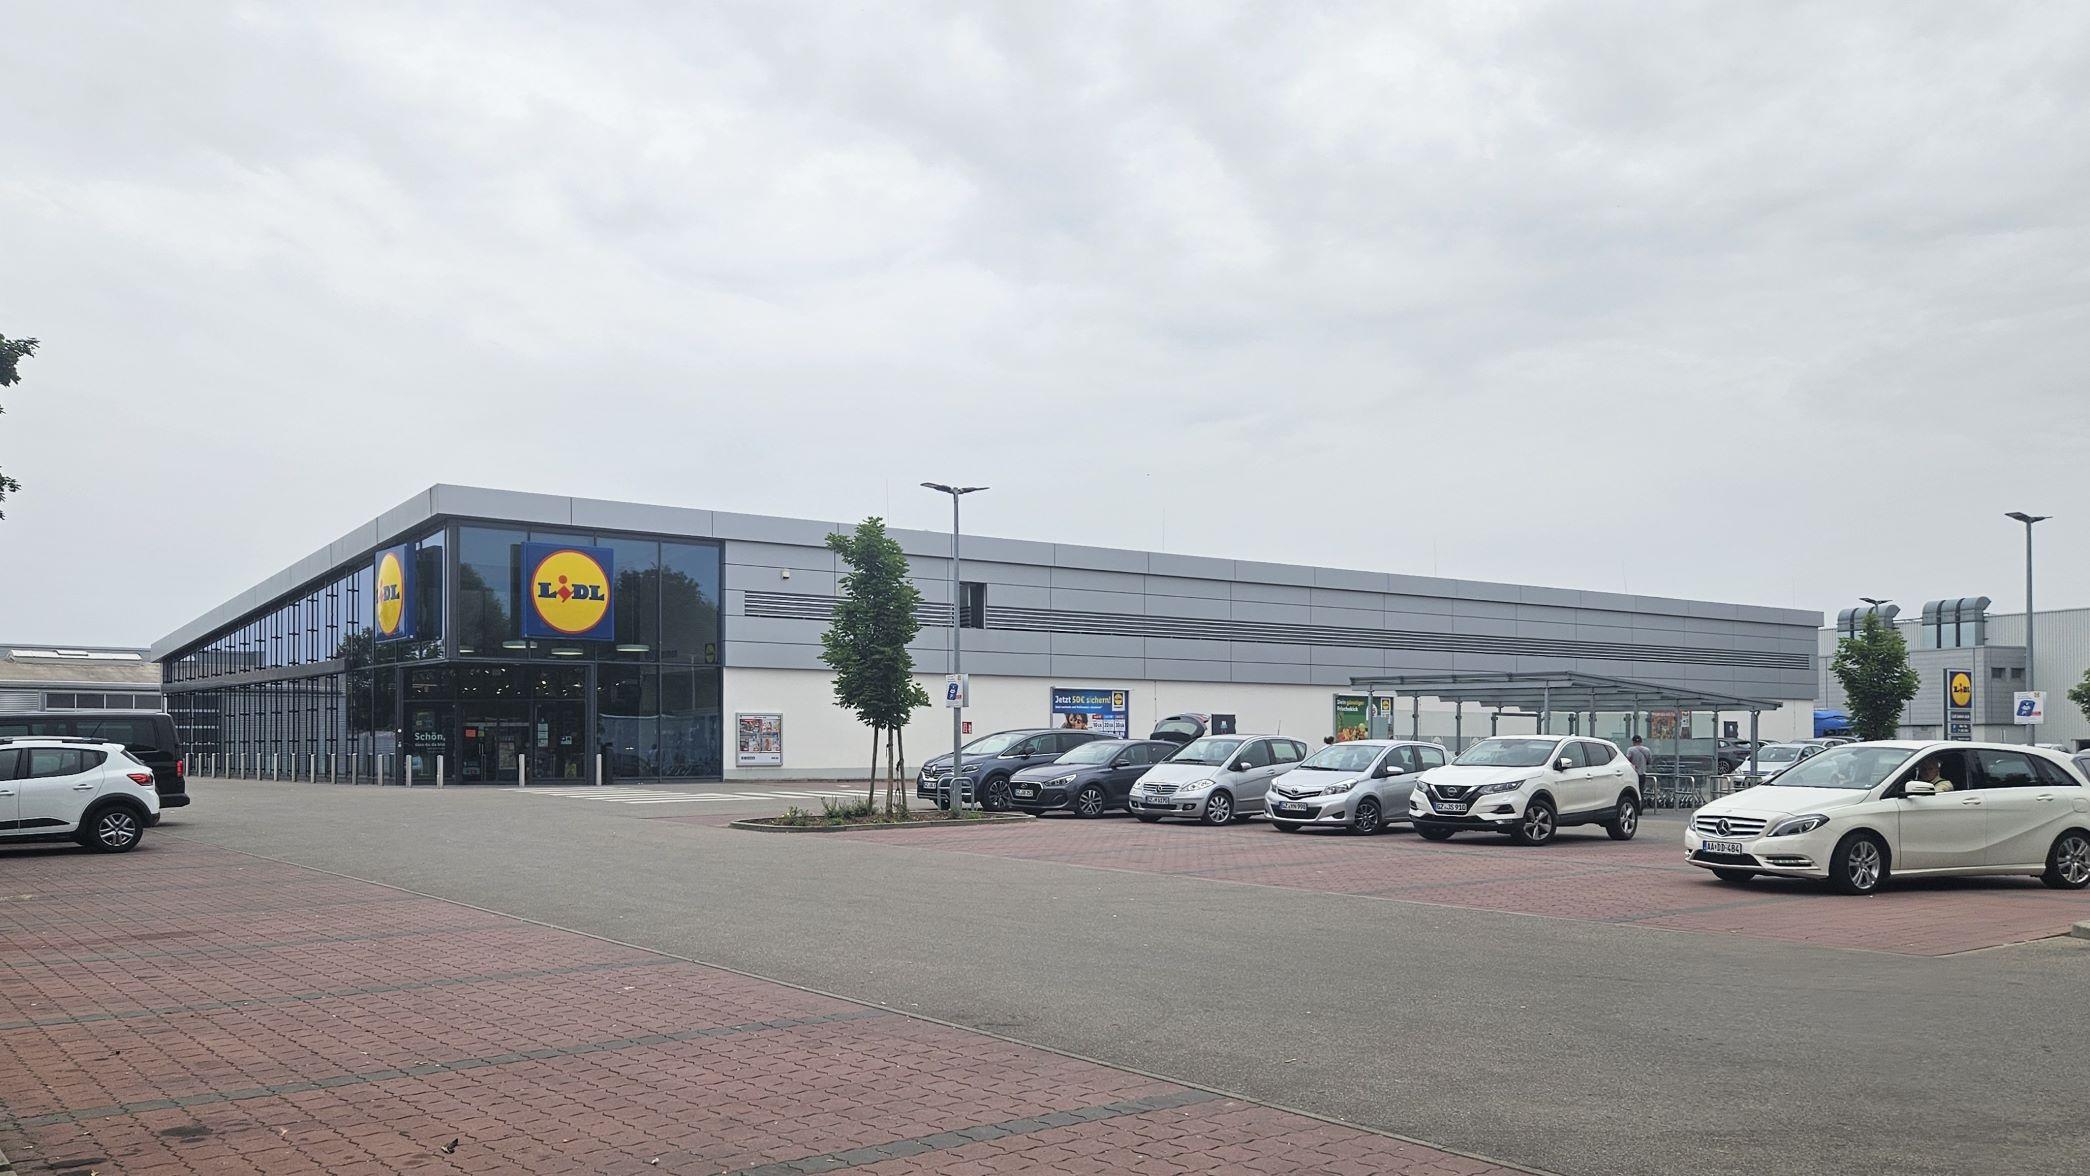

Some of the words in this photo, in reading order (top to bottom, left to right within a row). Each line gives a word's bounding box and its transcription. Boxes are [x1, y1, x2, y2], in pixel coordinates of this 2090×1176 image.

[1055, 695, 1071, 704] Jetzt
[1086, 696, 1111, 704] sichern!
[415, 732, 445, 741] Schön,
